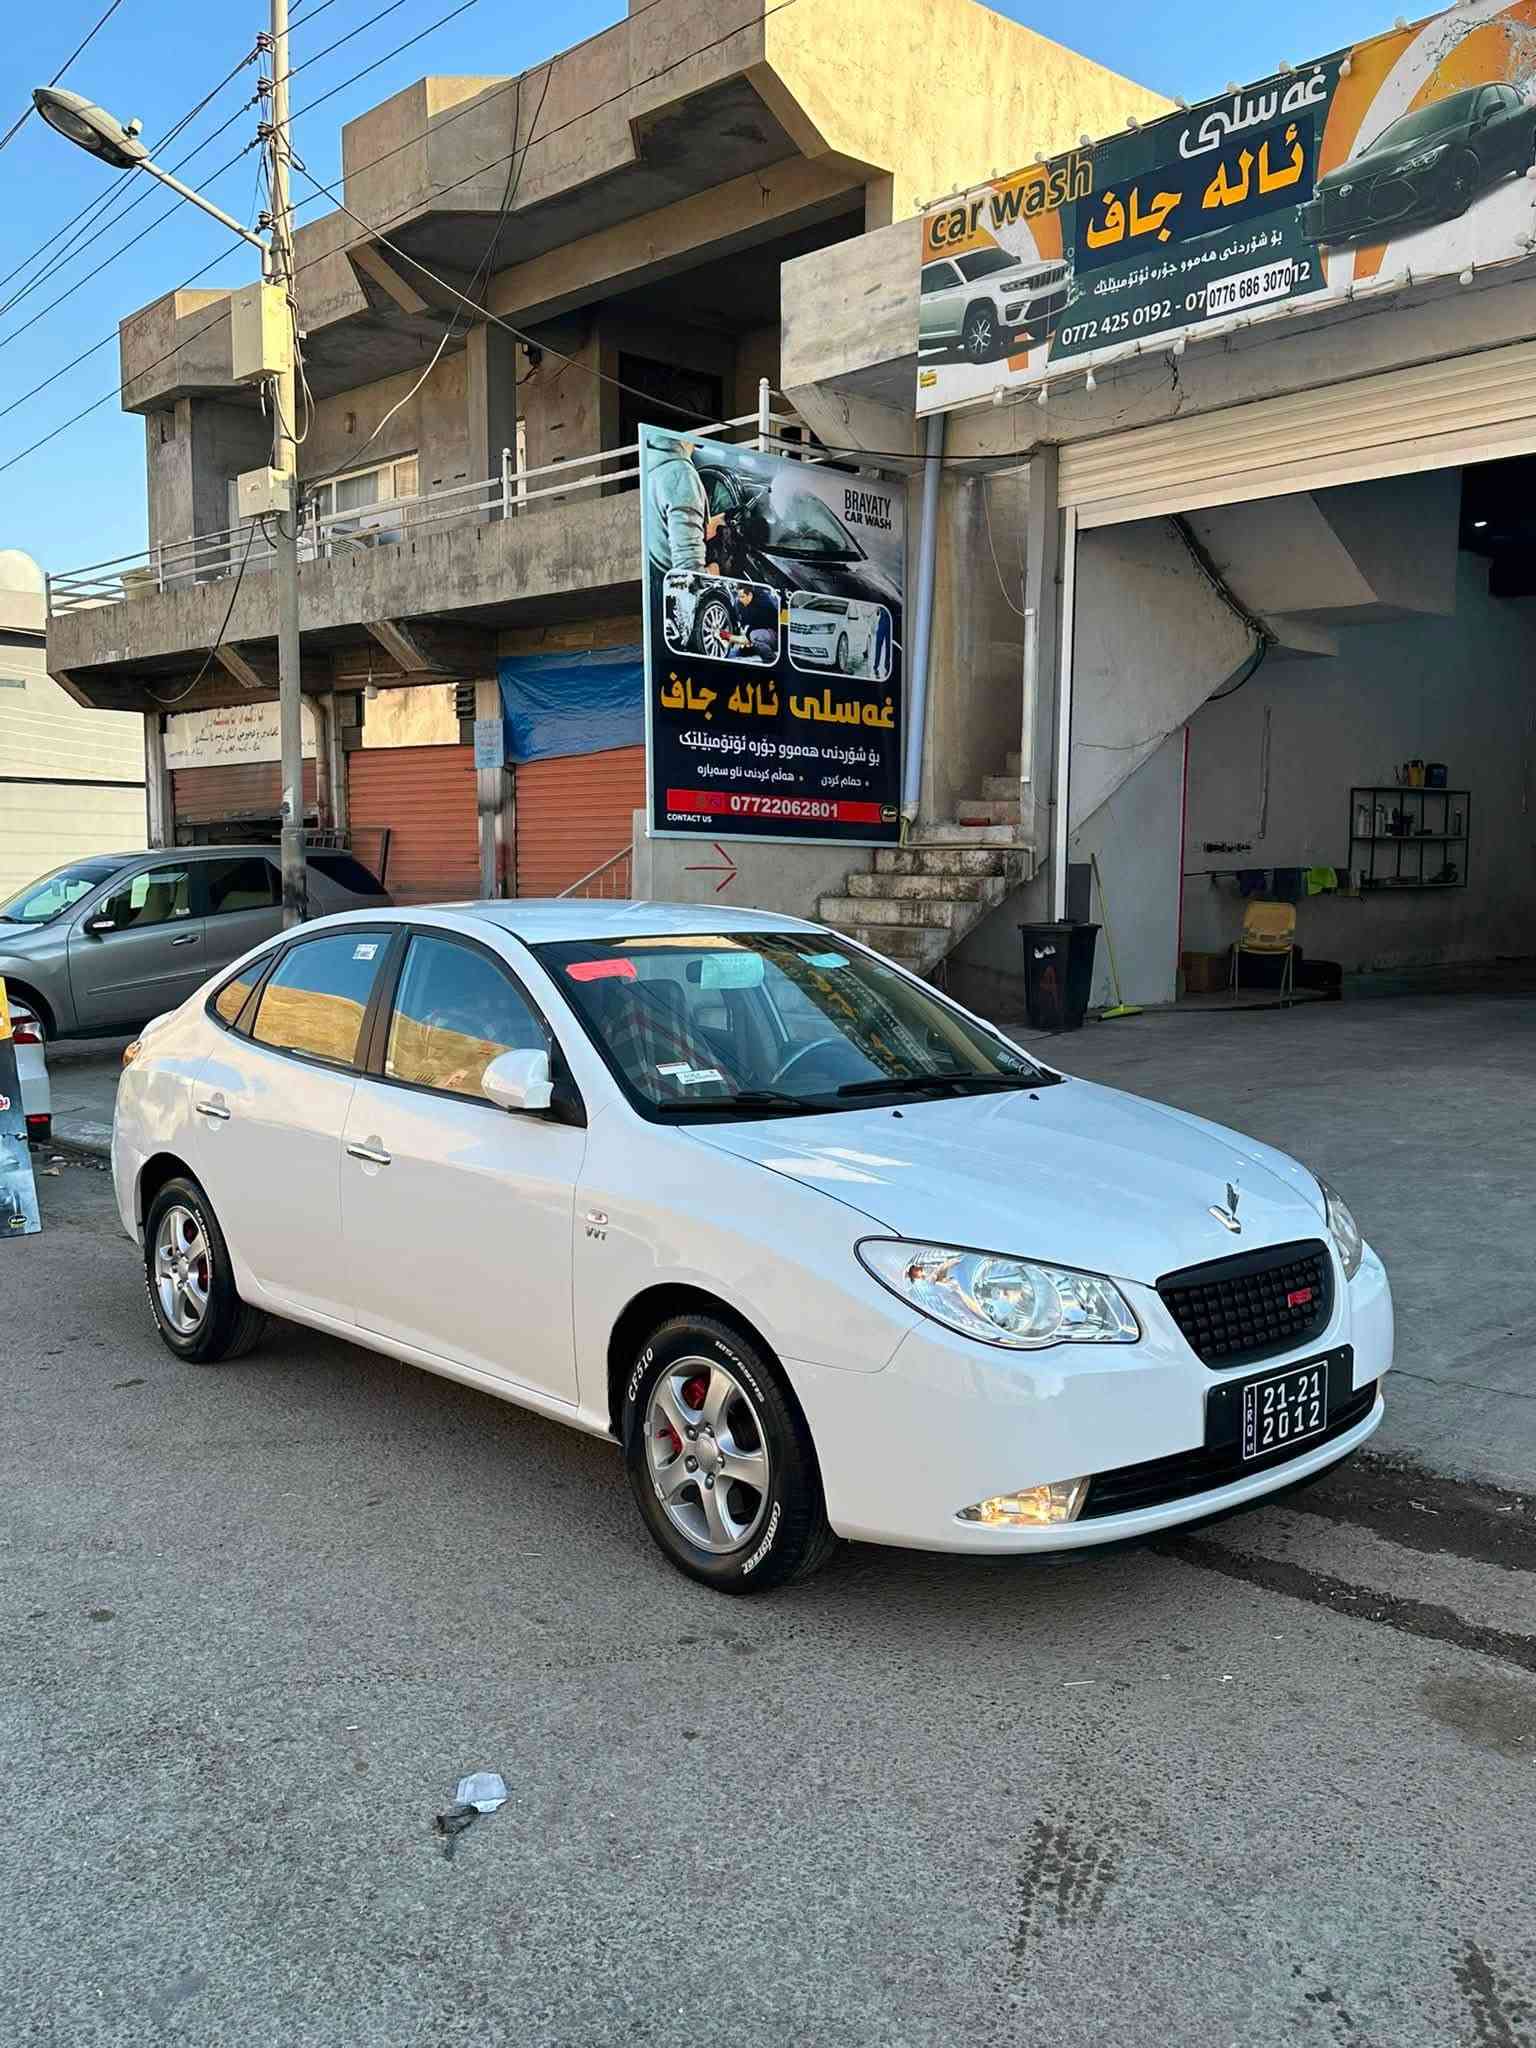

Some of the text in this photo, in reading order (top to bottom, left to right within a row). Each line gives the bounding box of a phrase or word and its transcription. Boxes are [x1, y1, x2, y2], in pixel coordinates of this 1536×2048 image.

[928, 156, 1093, 248] car wash
[1086, 187, 1183, 250] جاف
[1209, 266, 1292, 309] 0776 686 3070
[1061, 319, 1098, 346] 0772
[1101, 311, 1129, 335] 425
[1132, 299, 1172, 326] 0192
[844, 489, 891, 518] BRAYATY
[845, 510, 892, 530] CAR WASH
[660, 672, 718, 721] جاف
[868, 751, 881, 767] بۆ
[666, 813, 713, 823] CONTACT US
[730, 796, 839, 818] 07722062801
[628, 1347, 653, 1401] CF510
[1263, 1371, 1321, 1415] 21-21
[1263, 1400, 1320, 1445] 2012
